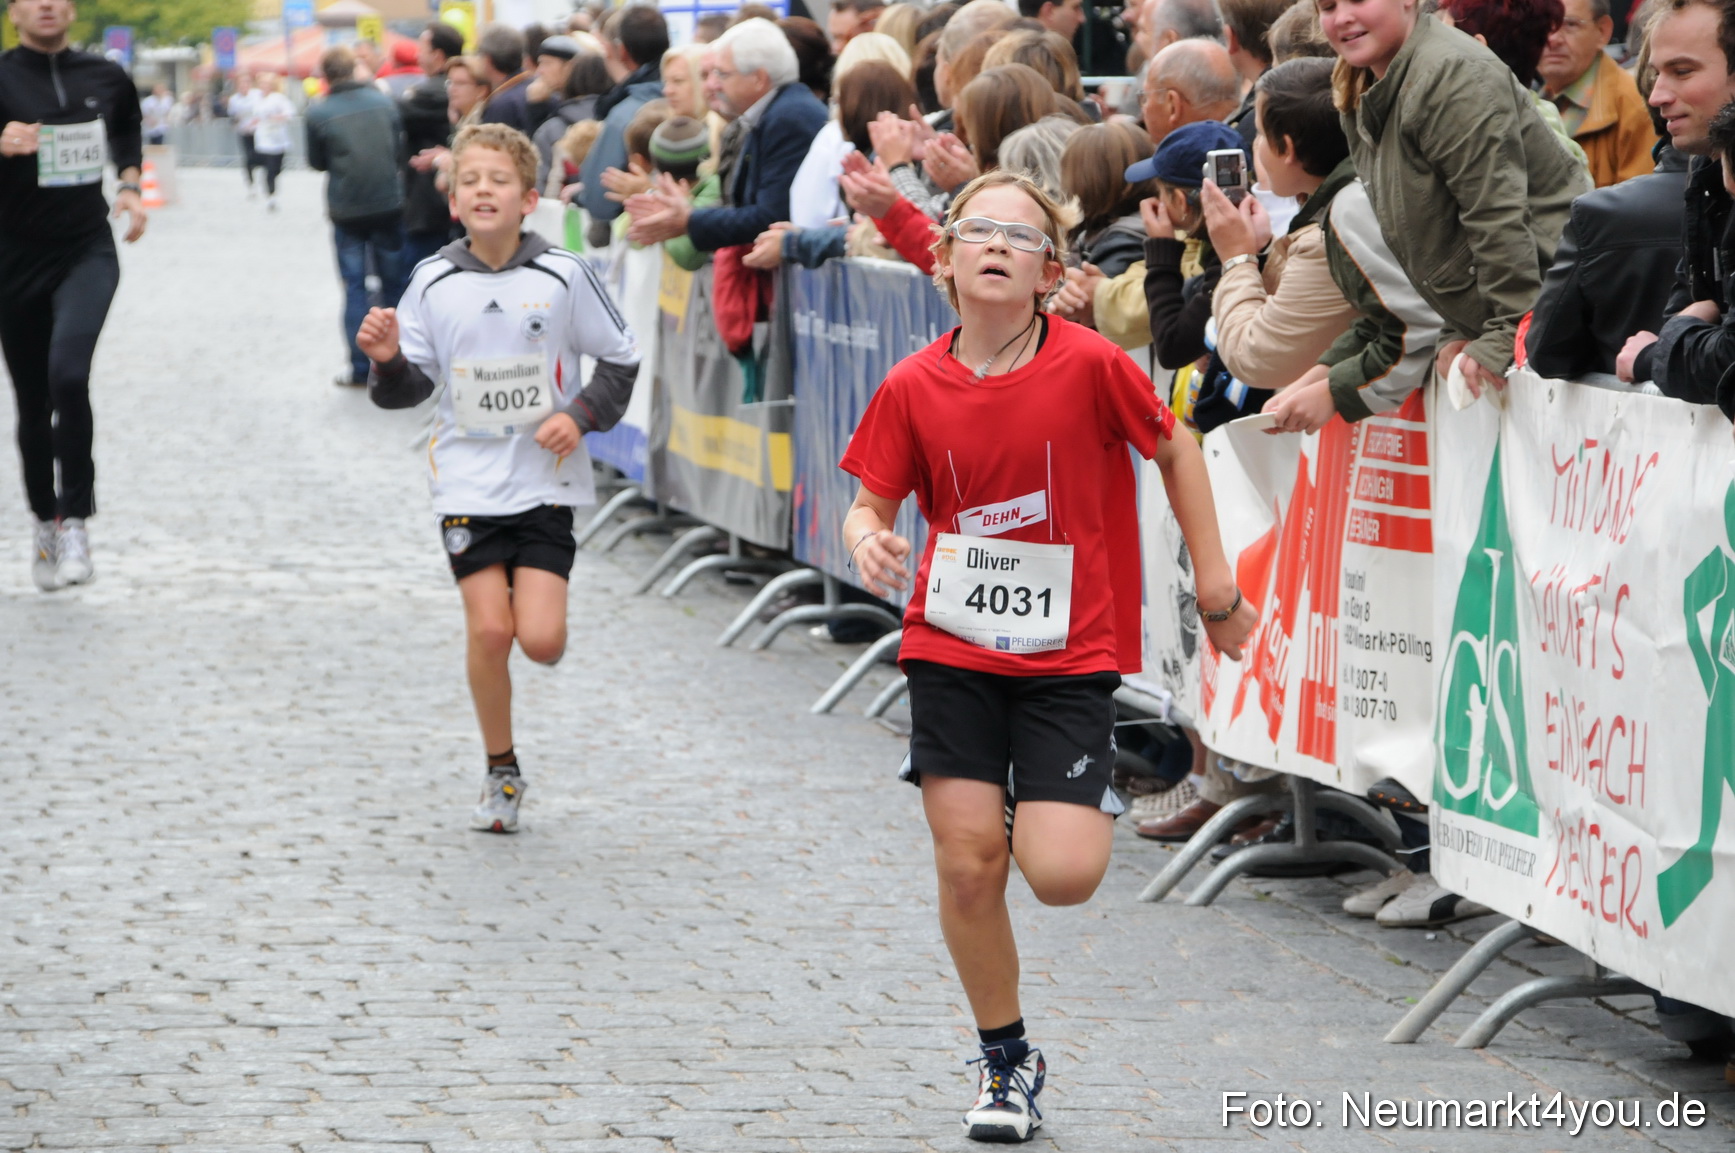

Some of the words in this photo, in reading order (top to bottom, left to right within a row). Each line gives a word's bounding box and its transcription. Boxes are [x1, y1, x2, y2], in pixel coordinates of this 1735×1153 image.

[473, 363, 541, 382] Maximilian
[478, 385, 542, 413] 4002
[982, 507, 1021, 528] DEHN
[966, 547, 1021, 571] Oliver
[932, 578, 942, 594] J
[965, 583, 1052, 618] 4031
[1011, 637, 1064, 647] PFLEIDERER
